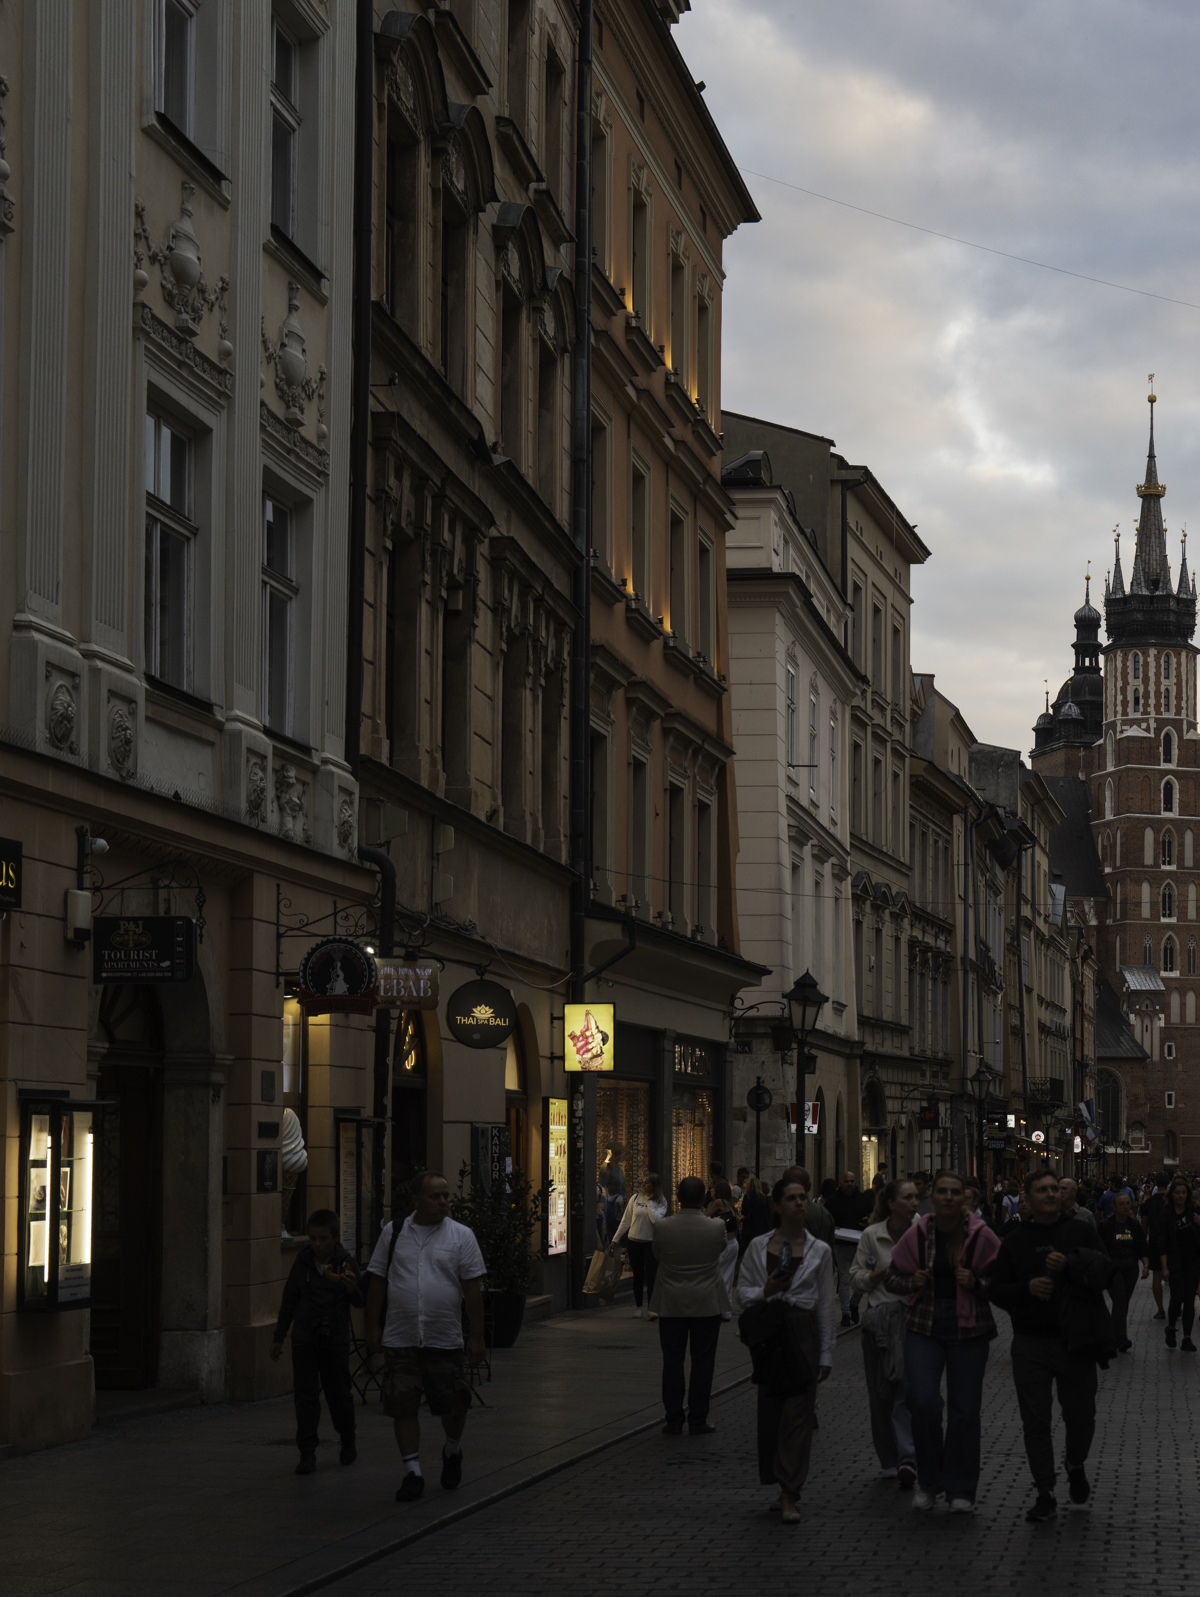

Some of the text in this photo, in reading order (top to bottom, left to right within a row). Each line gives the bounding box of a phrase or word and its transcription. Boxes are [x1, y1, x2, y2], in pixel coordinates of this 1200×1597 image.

[119, 921, 144, 934] P&J
[102, 950, 158, 960] TOURIST
[380, 965, 432, 976] PIEKANKI
[380, 978, 432, 997] EBAB
[455, 1016, 476, 1025] THAI
[489, 1018, 509, 1026] BALI
[492, 1127, 500, 1180] KANTOR
